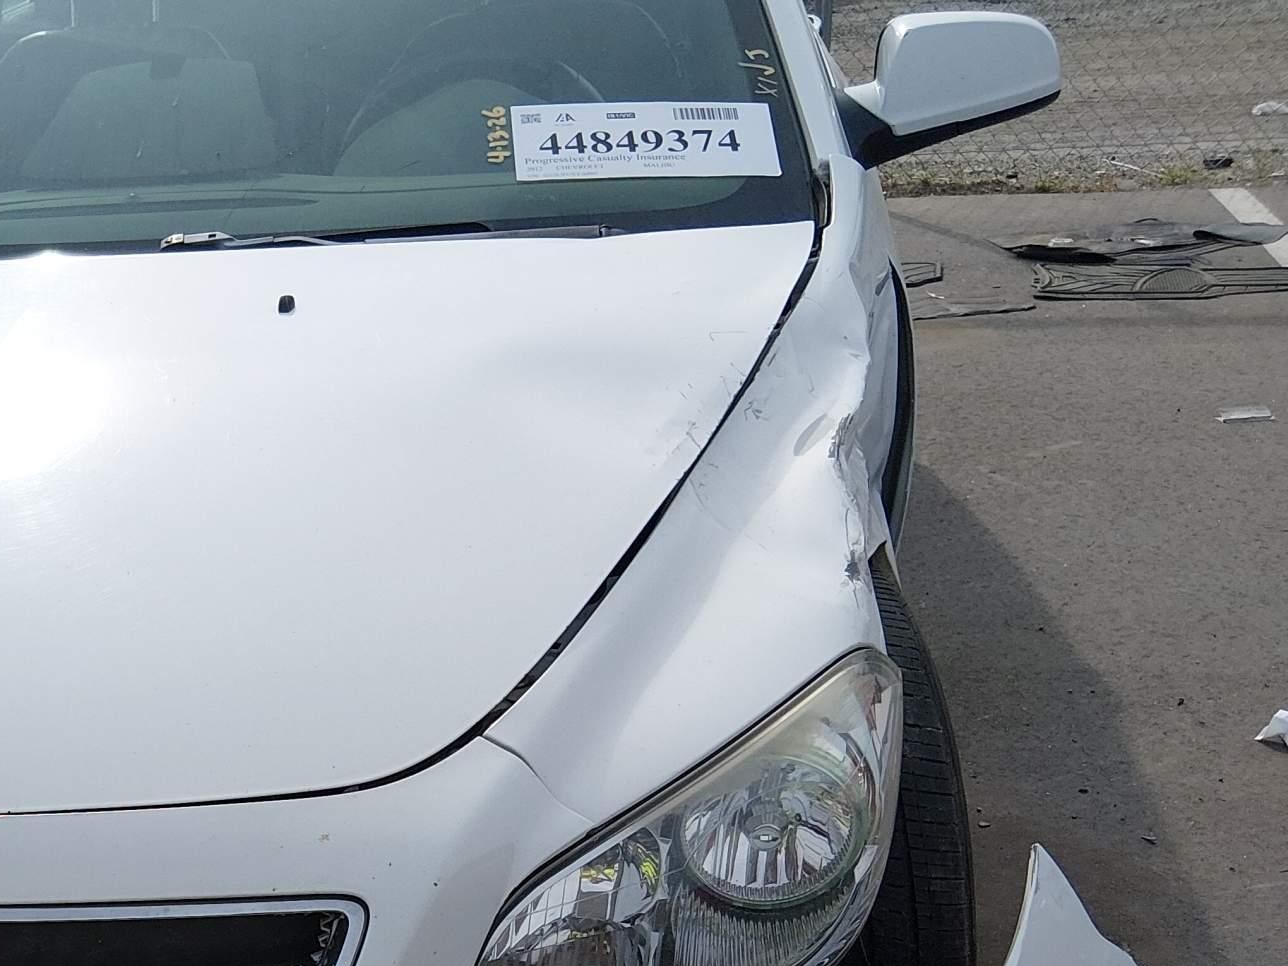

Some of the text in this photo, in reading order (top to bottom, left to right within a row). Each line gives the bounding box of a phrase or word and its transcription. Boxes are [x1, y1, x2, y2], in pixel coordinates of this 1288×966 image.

[539, 129, 741, 155] 44849374
[524, 153, 686, 166] Progressive Casualty Insurance
